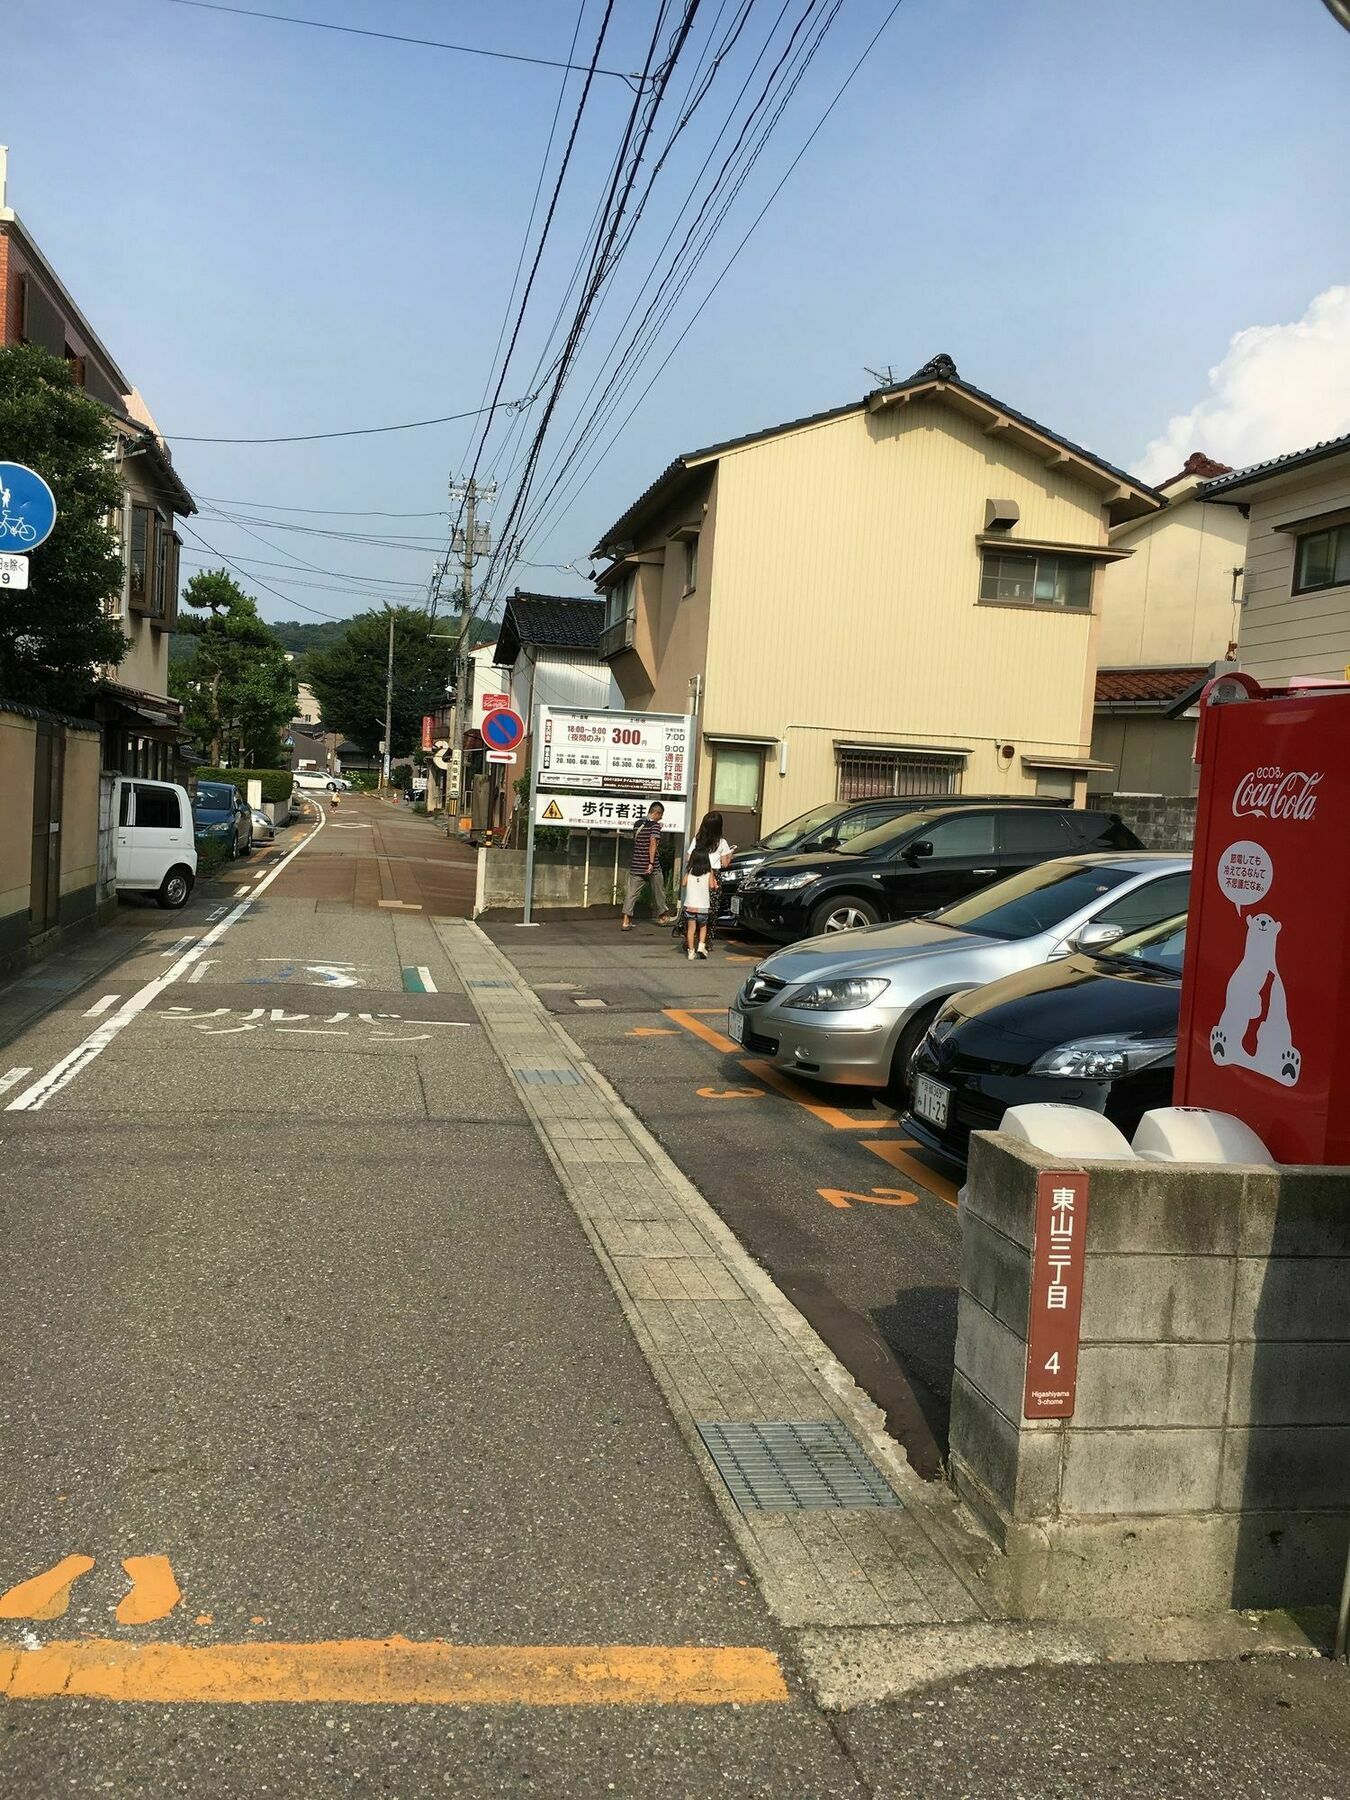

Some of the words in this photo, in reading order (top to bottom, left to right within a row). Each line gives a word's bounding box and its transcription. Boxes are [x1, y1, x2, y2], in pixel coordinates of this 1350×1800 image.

[666, 733, 685, 741] 7:00
[665, 745, 684, 753] 9:00
[664, 753, 673, 791] 通行禁止
[673, 753, 683, 791] 前面道路
[1232, 772, 1325, 820] Coca-Cola
[582, 802, 647, 819] 歩行者注
[1230, 854, 1261, 866] 節電しても
[1223, 865, 1266, 880] 冷えてるなんて
[1047, 1187, 1076, 1309] 東山三丁目
[1044, 1351, 1061, 1375] 4
[1032, 1390, 1070, 1398] Higashiyama
